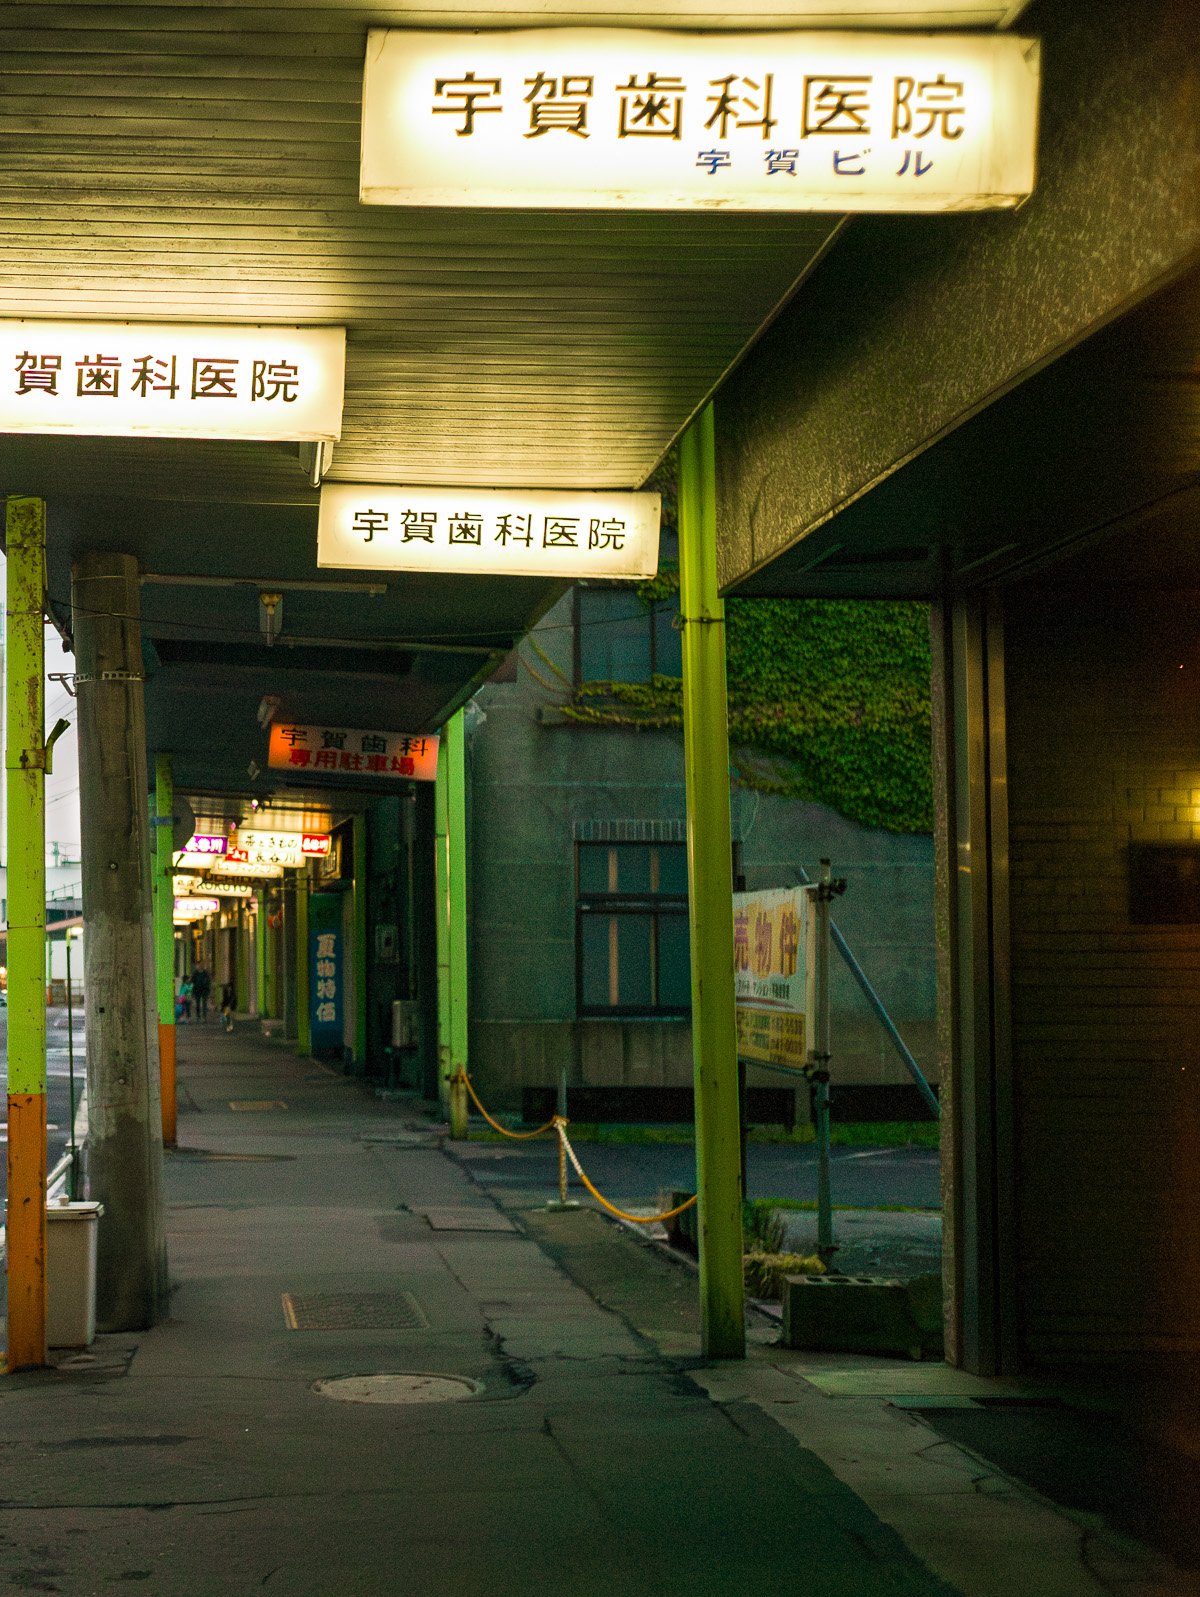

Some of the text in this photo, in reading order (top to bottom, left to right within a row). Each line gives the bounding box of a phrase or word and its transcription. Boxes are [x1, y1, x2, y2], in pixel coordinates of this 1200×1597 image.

[431, 71, 966, 141] 宇賀歯科医院
[696, 148, 934, 178] 宇賀ビル
[352, 508, 626, 551] 宇賀歯科医院
[280, 728, 429, 757] 宇賀歯科
[255, 852, 297, 864] 長谷川
